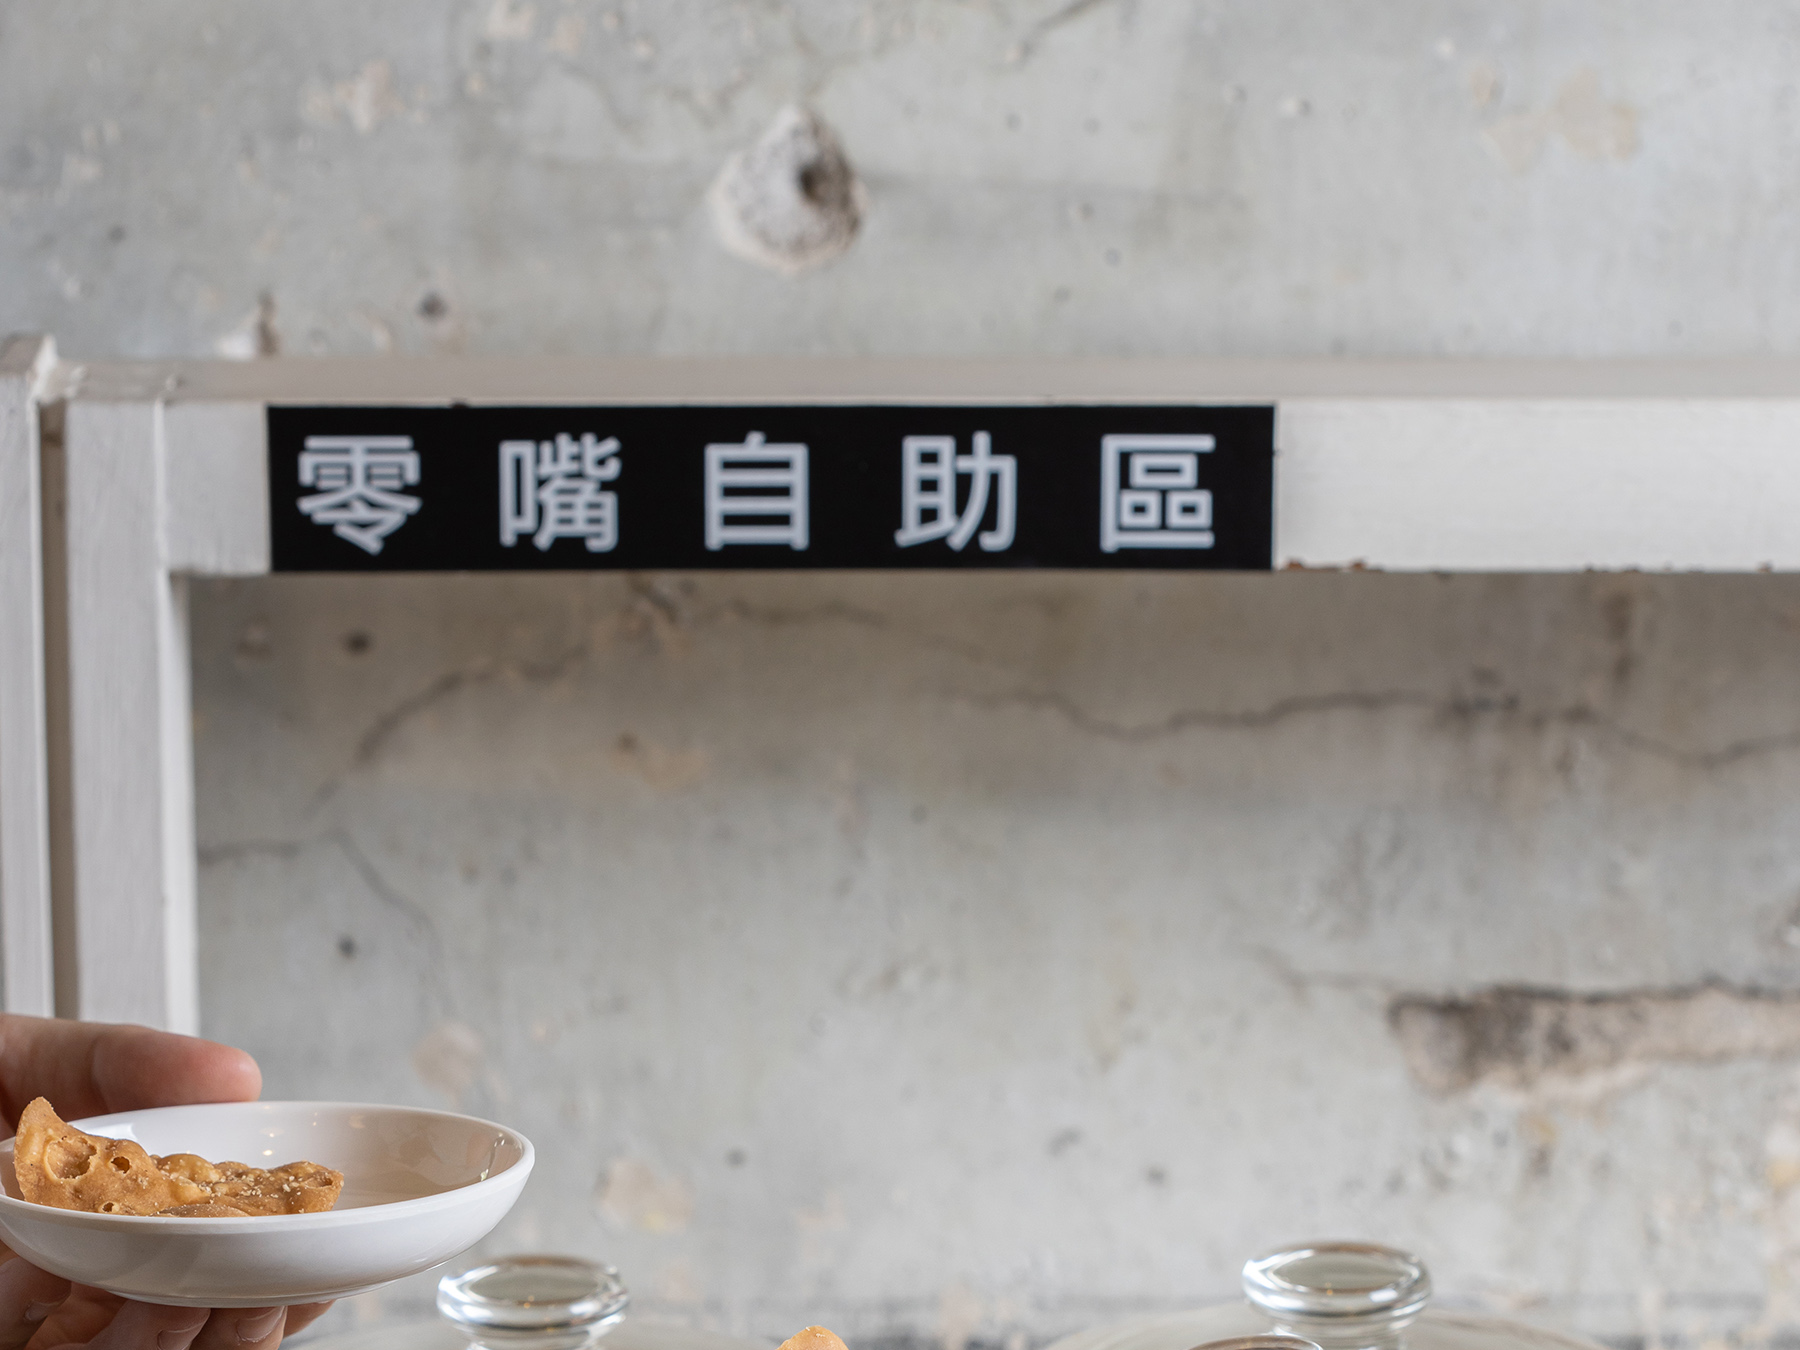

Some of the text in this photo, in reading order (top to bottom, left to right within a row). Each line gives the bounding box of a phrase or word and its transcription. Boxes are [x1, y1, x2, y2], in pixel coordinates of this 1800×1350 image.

[298, 431, 1216, 552] 零嘴自助區
